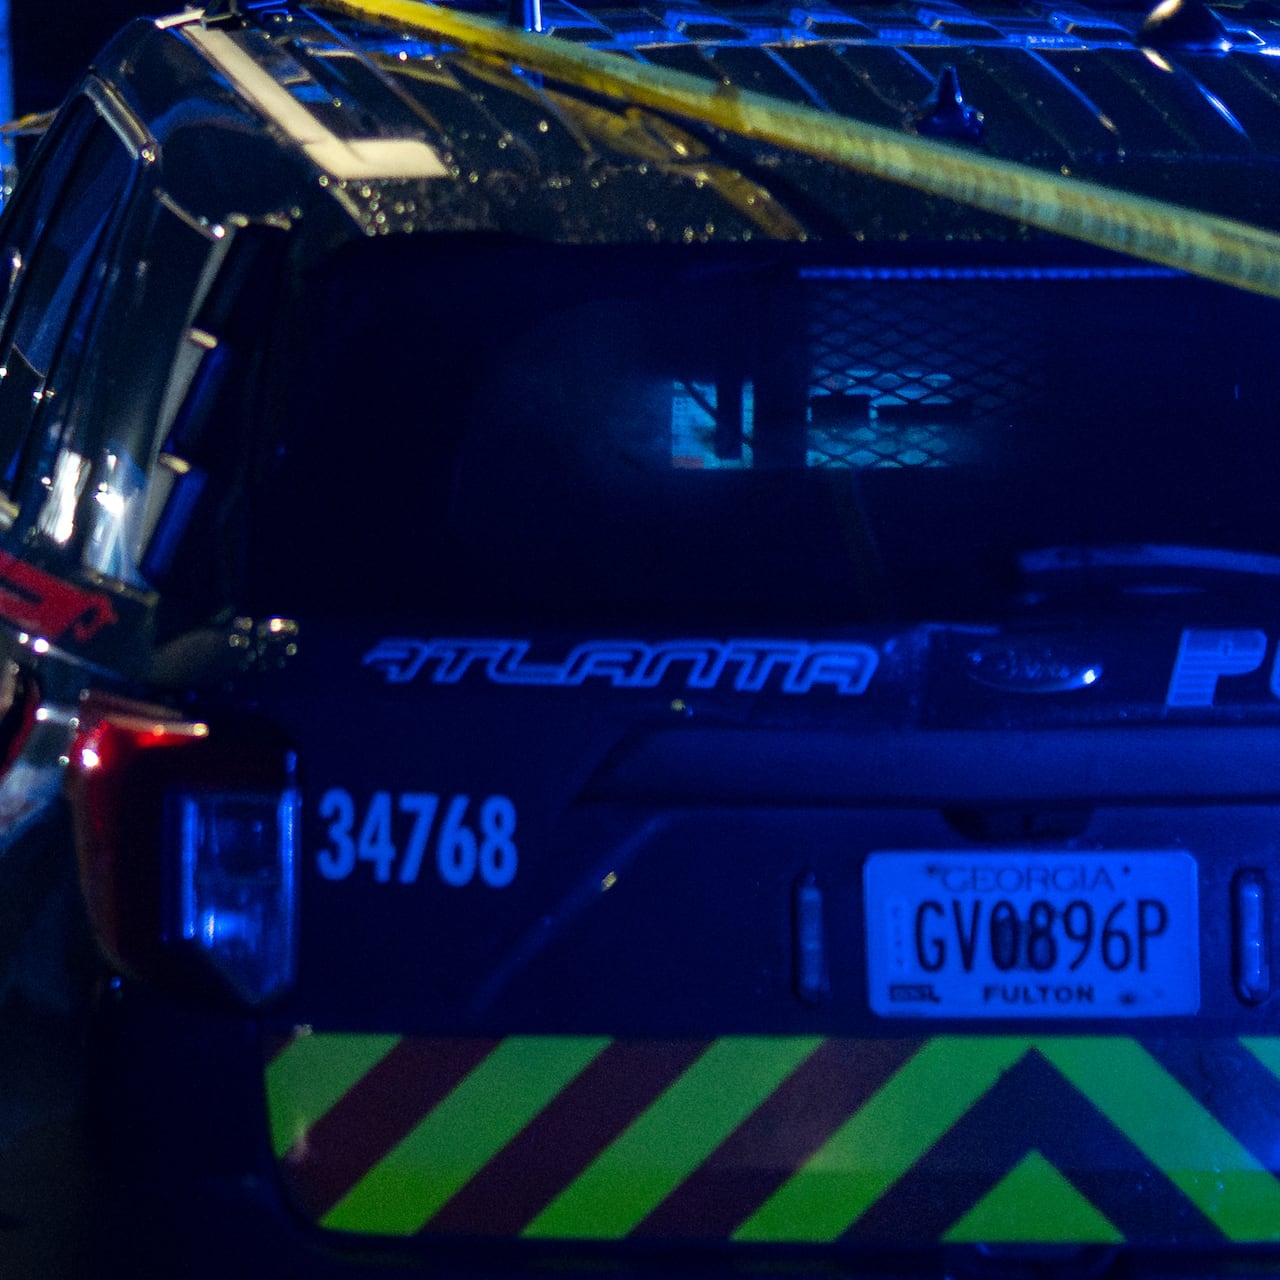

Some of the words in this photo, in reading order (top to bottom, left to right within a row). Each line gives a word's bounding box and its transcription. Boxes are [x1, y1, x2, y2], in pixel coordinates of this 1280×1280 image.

[361, 637, 882, 697] ATLANTA
[1164, 627, 1280, 708] P
[316, 787, 520, 889] 34768
[940, 865, 1116, 894] GEORGIA
[914, 898, 1170, 973] GV0896P
[982, 984, 1096, 1004] FULTON
